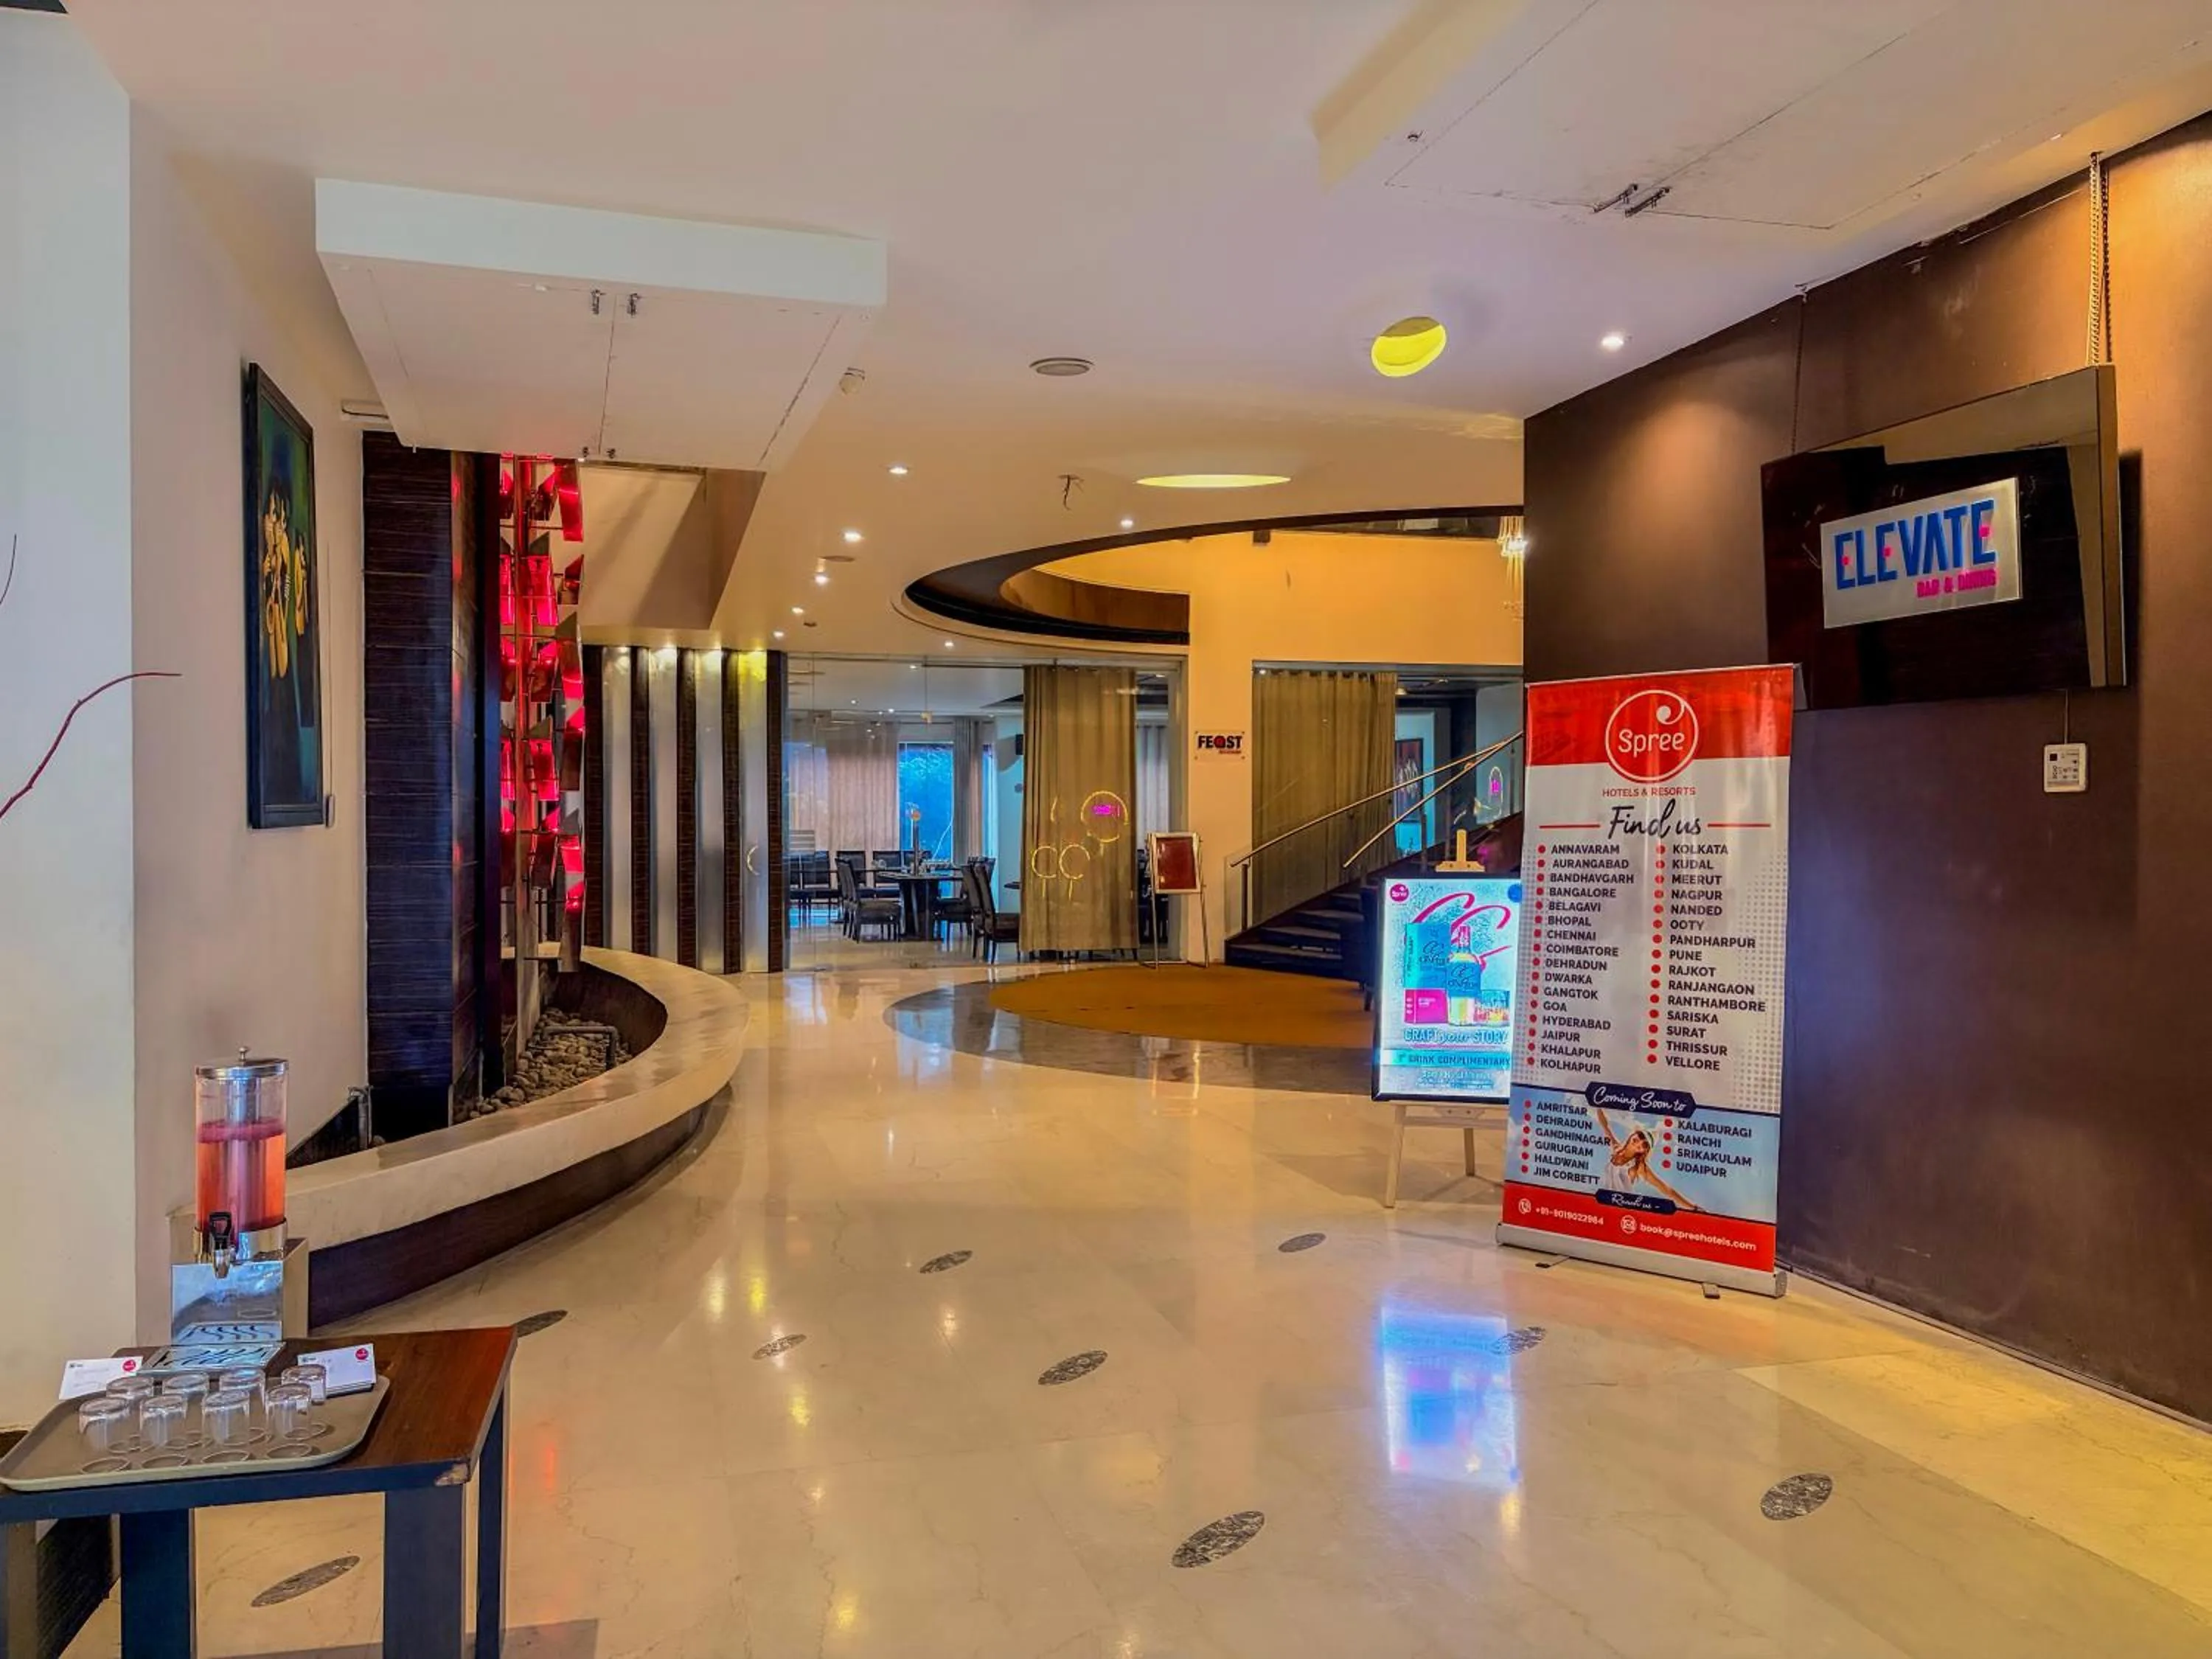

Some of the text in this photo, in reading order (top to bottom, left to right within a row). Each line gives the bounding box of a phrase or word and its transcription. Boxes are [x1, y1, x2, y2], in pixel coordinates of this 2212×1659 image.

[1834, 498, 1996, 590] ELEVATE
[1618, 729, 1685, 758] Spree
[1602, 786, 1696, 797] HOTELS & RESORTS
[1607, 798, 1701, 839] Find us
[1551, 844, 1620, 855] ANNAVARAM
[1673, 844, 1728, 855] KOLKATA
[1552, 859, 1630, 869] AURANGABAD
[1672, 859, 1714, 869] KUDAL
[1550, 872, 1635, 883] BANDHAVGARH
[1672, 874, 1722, 885] MEERUT
[1549, 887, 1617, 898] BANGALORE
[1671, 890, 1723, 900] NAGPUR
[1548, 902, 1601, 912] BELAGAVI
[1671, 905, 1722, 916] NANDED
[1548, 916, 1592, 926] BHOPAL
[1670, 919, 1705, 931] OOTY
[1547, 930, 1596, 940] CHENNAI
[1669, 934, 1756, 948] PANDHARPUR
[1546, 945, 1619, 956] COIMBATORE
[1669, 949, 1703, 961] PUNE
[1545, 958, 1607, 970] DEHRADUN
[1669, 964, 1716, 977] RAJKOT
[1545, 973, 1593, 984] DWARKA
[1544, 987, 1599, 1001] GANGTOK
[1668, 980, 1755, 995] RANJANGAON
[1543, 1002, 1567, 1012] GOA
[1668, 995, 1766, 1012] RANTHAMBORE
[1543, 1016, 1611, 1030] HYDERABAD
[1667, 1010, 1719, 1024] SARISKA
[1541, 1031, 1580, 1042] JAIPUR
[1666, 1026, 1706, 1038] SURAT
[1540, 1044, 1601, 1059] KHALAPUR
[1666, 1040, 1728, 1056] THRISSUR
[1540, 1059, 1601, 1074] KOLHAPUR
[1666, 1055, 1720, 1071] VELLORE
[1593, 1086, 1687, 1112] Coming Soon to
[1536, 1101, 1587, 1116] AMRITSAR
[1536, 1114, 1593, 1130] DEHRADUN
[1677, 1120, 1752, 1138] KALABURAGI
[1535, 1128, 1611, 1147] GANDHINAGAR
[1677, 1134, 1722, 1148] RANCHI
[1534, 1141, 1593, 1157] GURUGRAM
[1534, 1154, 1589, 1170] HALDWANI
[1677, 1148, 1752, 1166] SRIKAKULAM
[1533, 1167, 1601, 1185] JIM CORBETT
[1676, 1161, 1727, 1178] UDAIPUR
[1639, 1222, 1757, 1251] book@spreehotels.com
